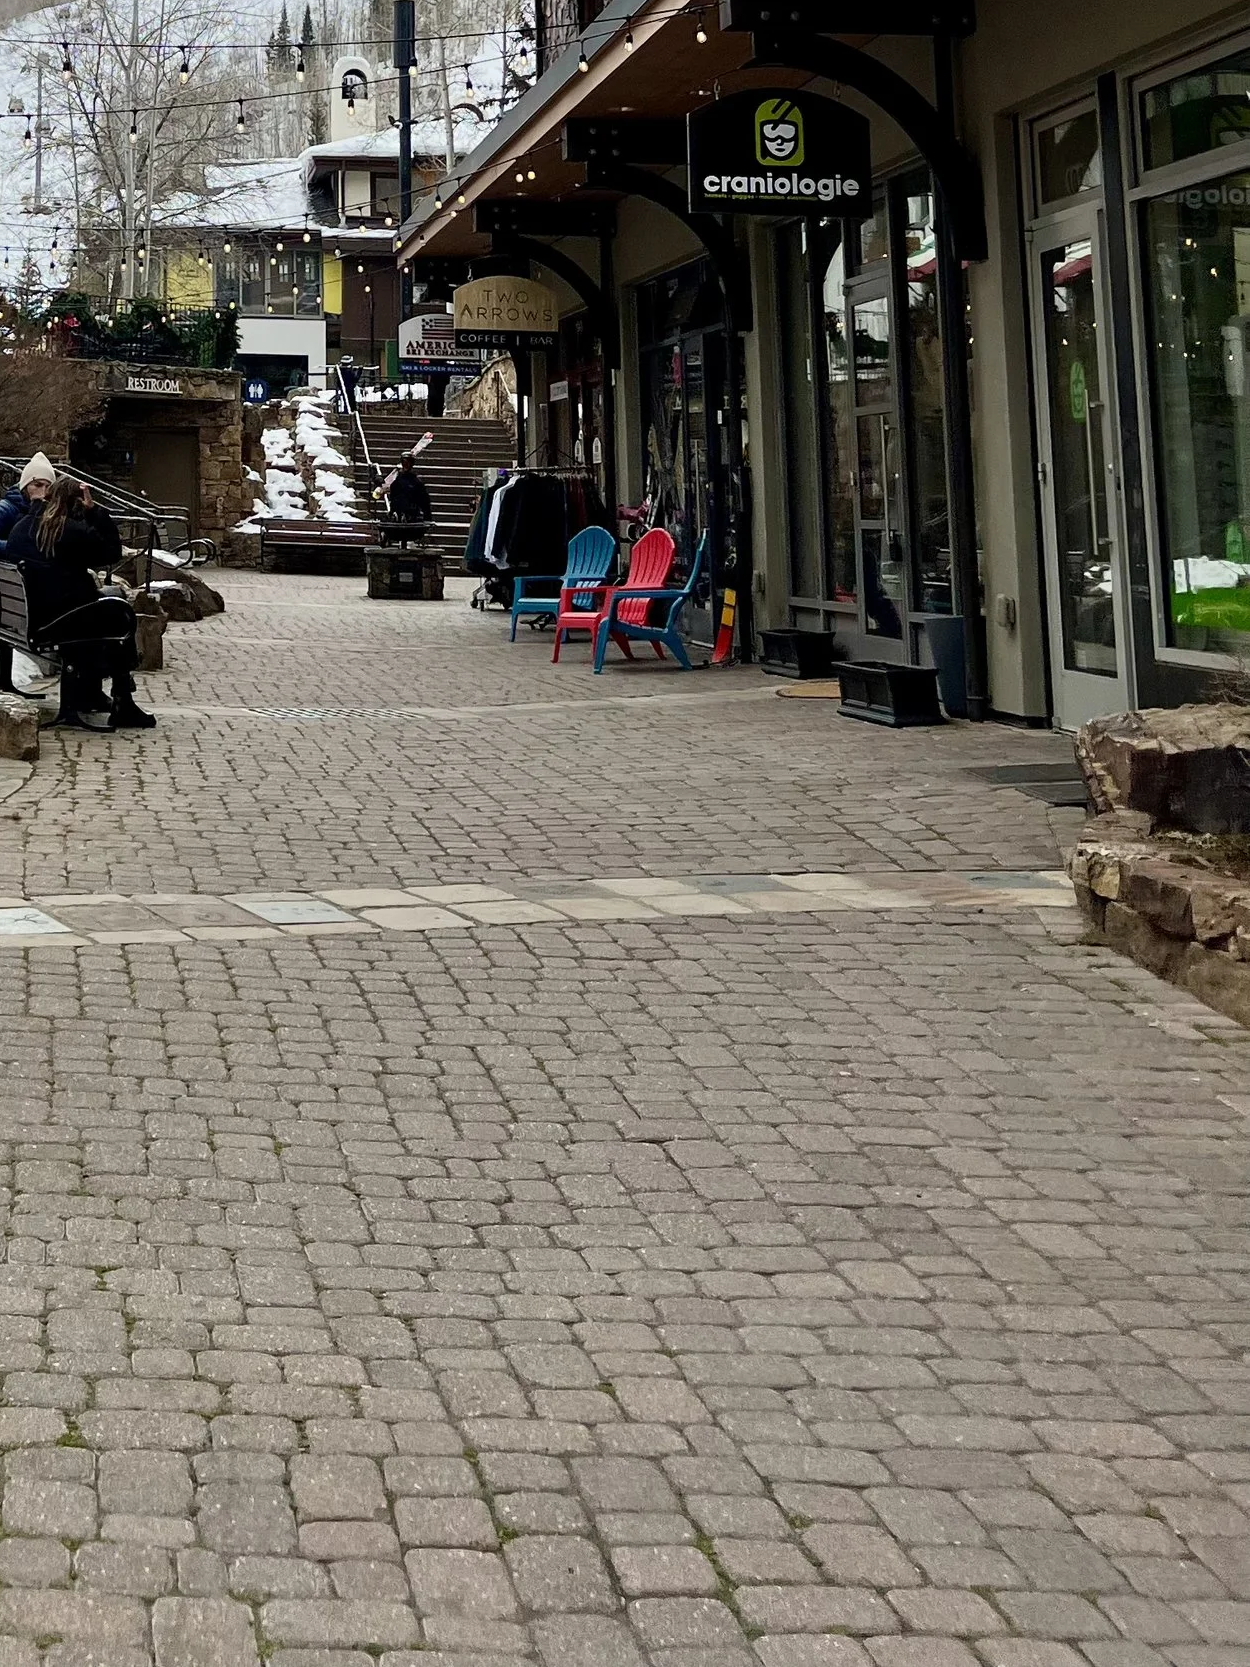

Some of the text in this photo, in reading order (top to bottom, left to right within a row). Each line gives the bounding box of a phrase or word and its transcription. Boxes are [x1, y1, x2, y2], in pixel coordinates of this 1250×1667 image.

[703, 172, 860, 201] craniologie
[483, 289, 529, 304] TWO
[460, 303, 553, 322] ARROWS
[406, 340, 456, 350] AMERIC
[460, 334, 554, 346] COFFEE BAR
[424, 349, 476, 357] EXCHANGE
[419, 365, 446, 373] LOCKER
[447, 366, 478, 374] RENTALS
[127, 376, 180, 392] RESTROOM
